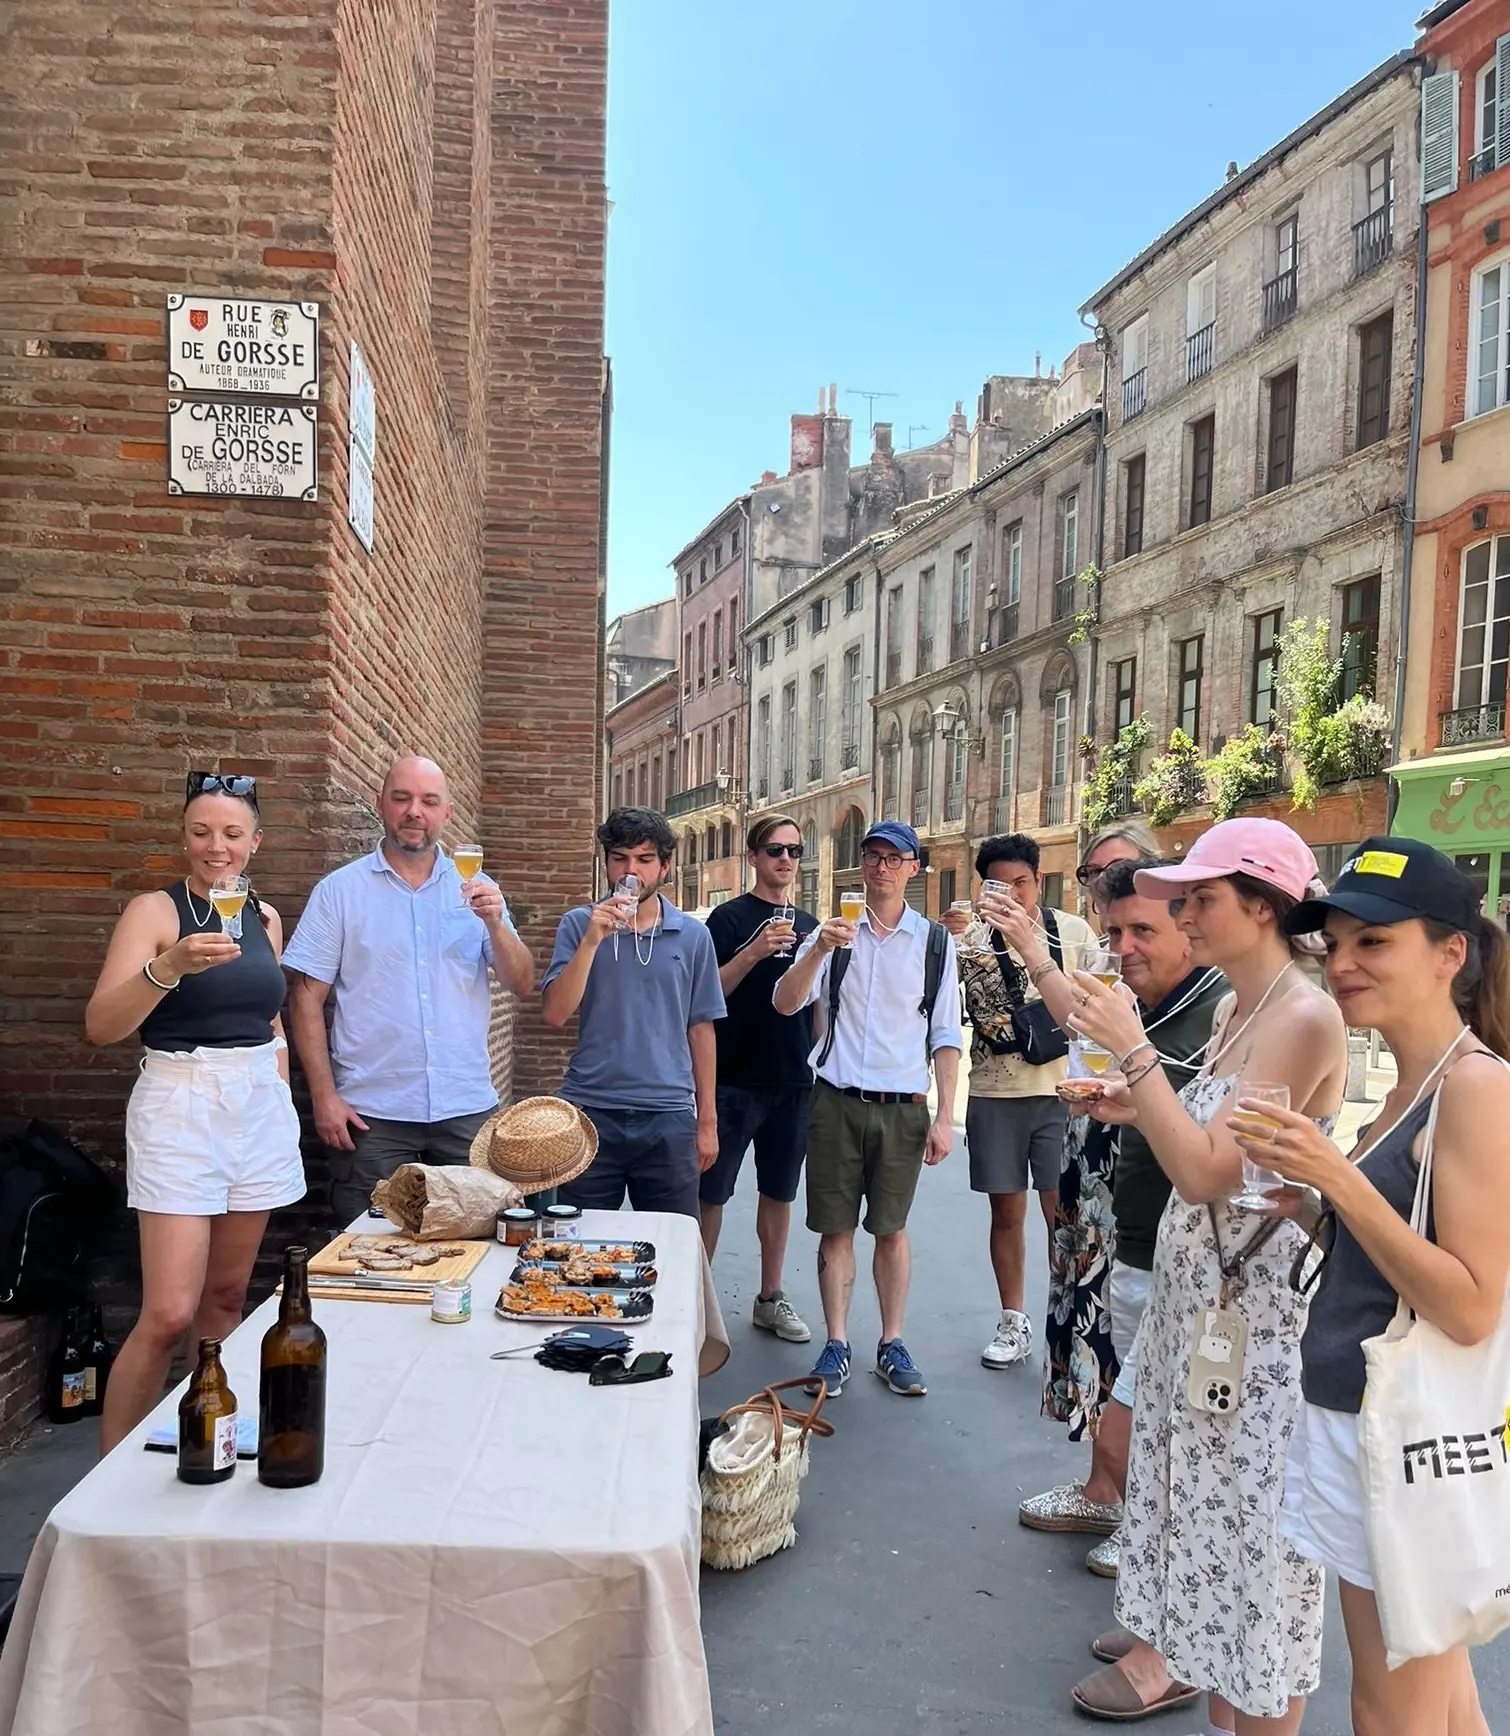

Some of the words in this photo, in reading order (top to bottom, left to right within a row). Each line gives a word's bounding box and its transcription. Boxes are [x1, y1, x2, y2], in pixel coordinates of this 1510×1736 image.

[222, 304, 262, 323] RUE
[227, 323, 259, 339] HENRI
[181, 341, 204, 360] DE
[218, 340, 304, 367] GORSSE
[199, 363, 232, 376] AUTEUR
[237, 366, 287, 380] DRAMATIQUE
[215, 423, 270, 439] ENRIC
[181, 445, 204, 460] DE
[212, 437, 303, 465] GORSSE
[243, 462, 260, 474] DEL
[272, 464, 296, 476] FORN
[205, 472, 217, 483] DE
[222, 473, 234, 483] LA
[240, 473, 280, 485] DALBADA
